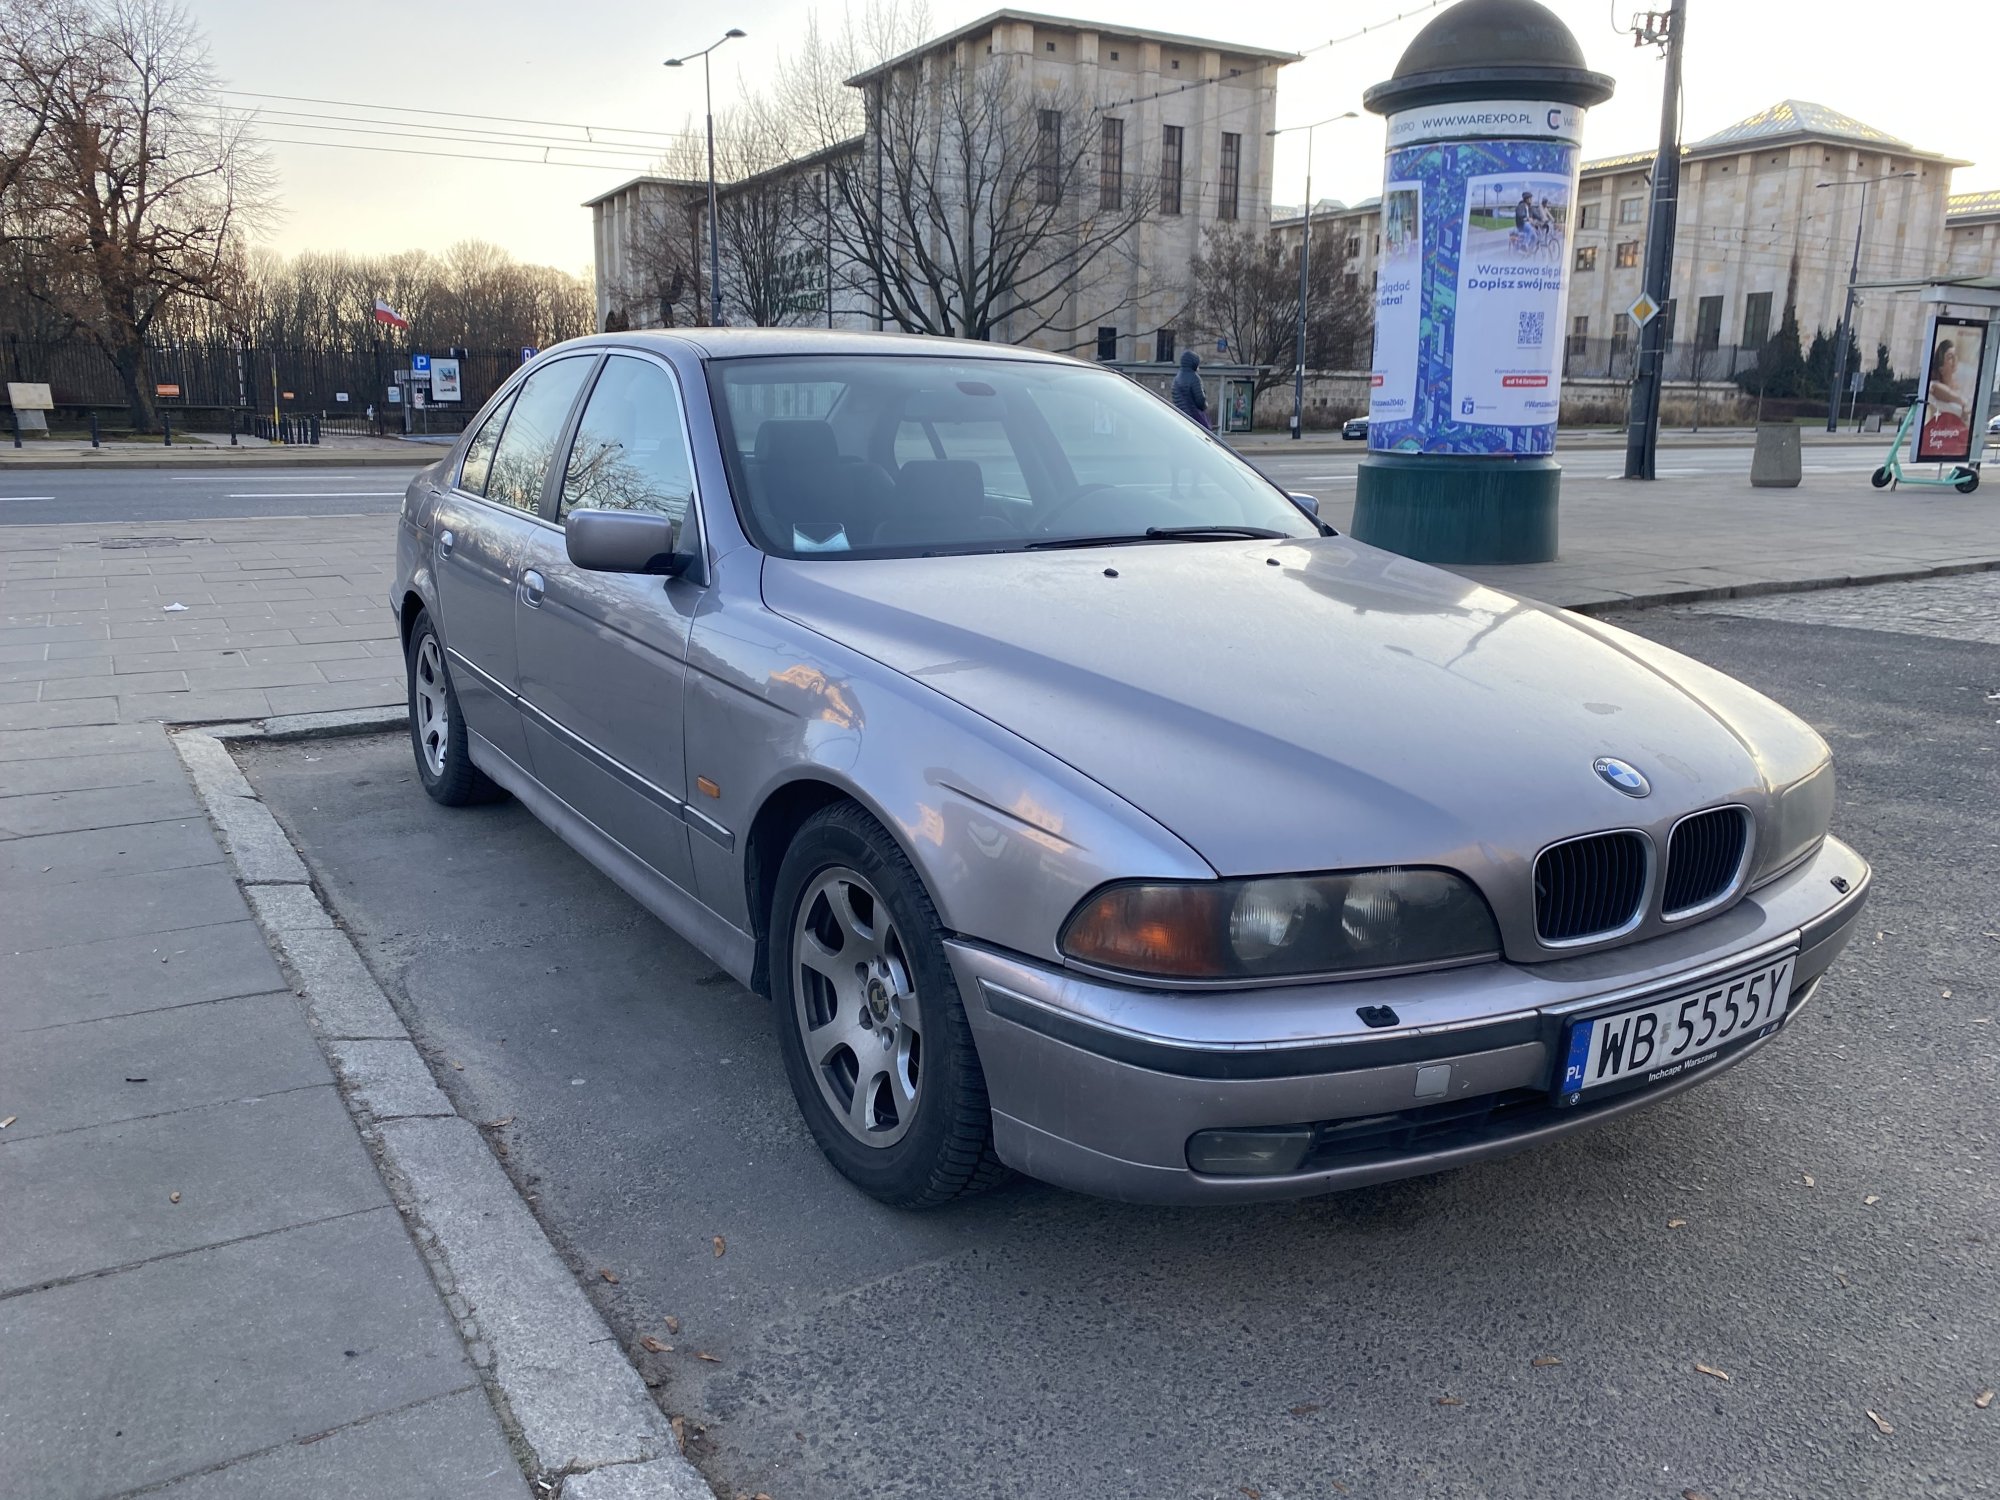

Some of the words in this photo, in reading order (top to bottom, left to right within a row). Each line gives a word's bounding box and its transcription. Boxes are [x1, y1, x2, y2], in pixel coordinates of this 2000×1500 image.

[1422, 114, 1532, 129] WWW.WAREXPO.PL
[1477, 264, 1539, 276] Warszawa
[1467, 278, 1515, 291] Dopisz
[1516, 278, 1543, 292] swój
[416, 356, 427, 369] P
[1597, 1012, 1658, 1079] WB
[1671, 963, 1788, 1056] 5555Y
[1648, 1064, 1682, 1082] Inchcape
[1684, 1051, 1718, 1069] Warszawa
[1566, 1066, 1582, 1083] PL
